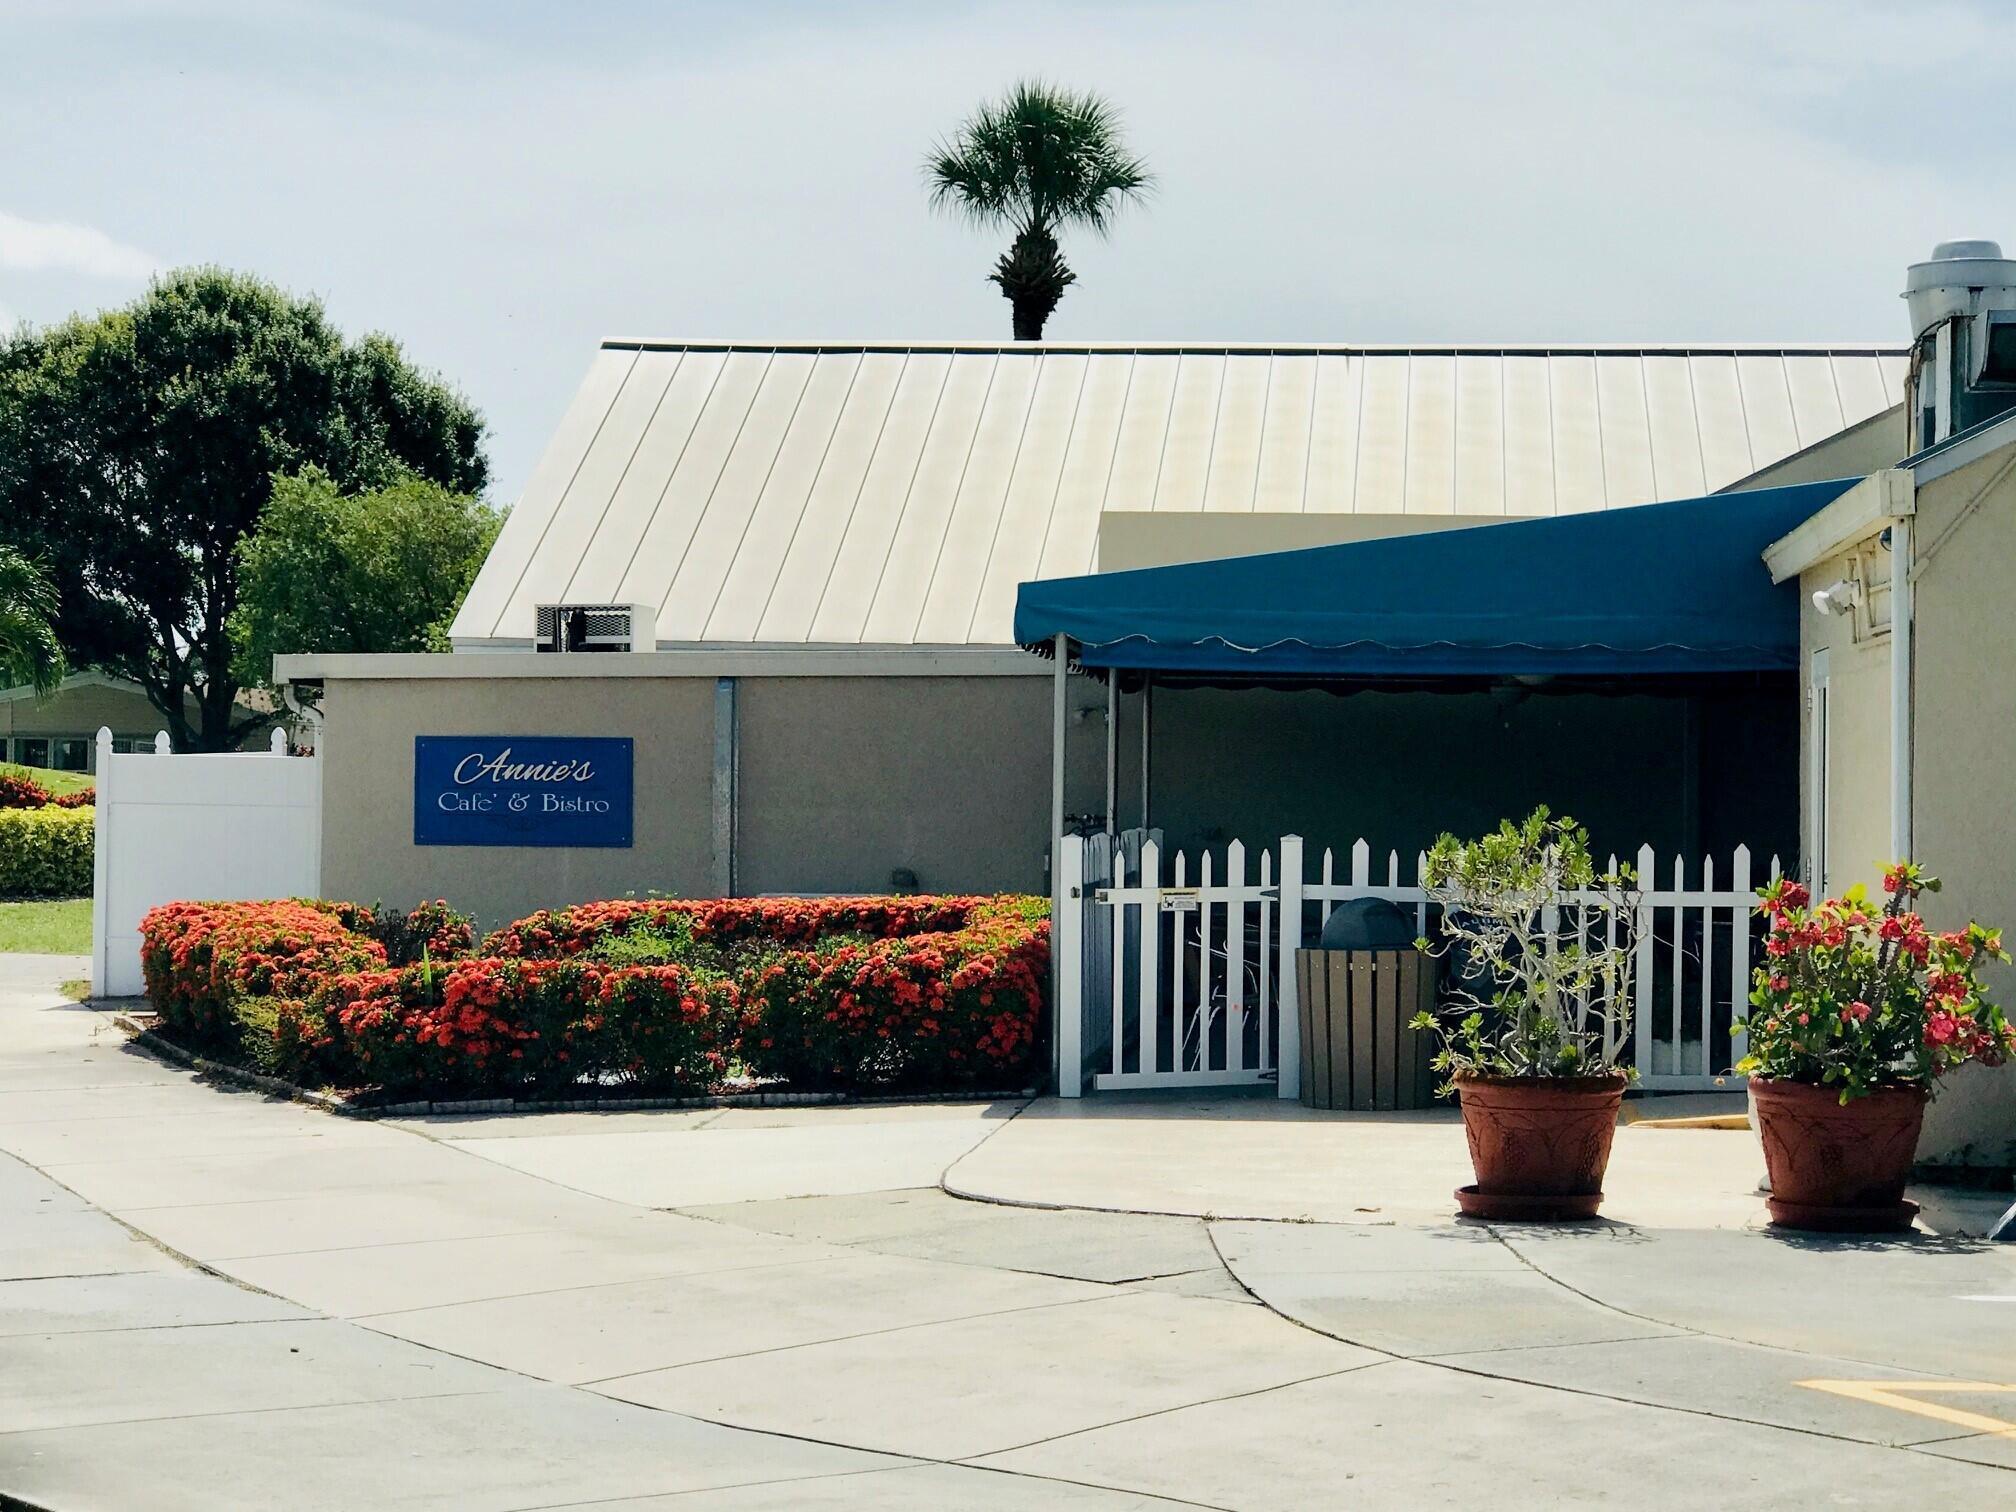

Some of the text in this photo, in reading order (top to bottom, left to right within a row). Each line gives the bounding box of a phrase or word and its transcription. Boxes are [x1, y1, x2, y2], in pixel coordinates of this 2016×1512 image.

[453, 748, 596, 785] Annie's
[508, 793, 530, 812] &
[541, 793, 610, 813] Bistro
